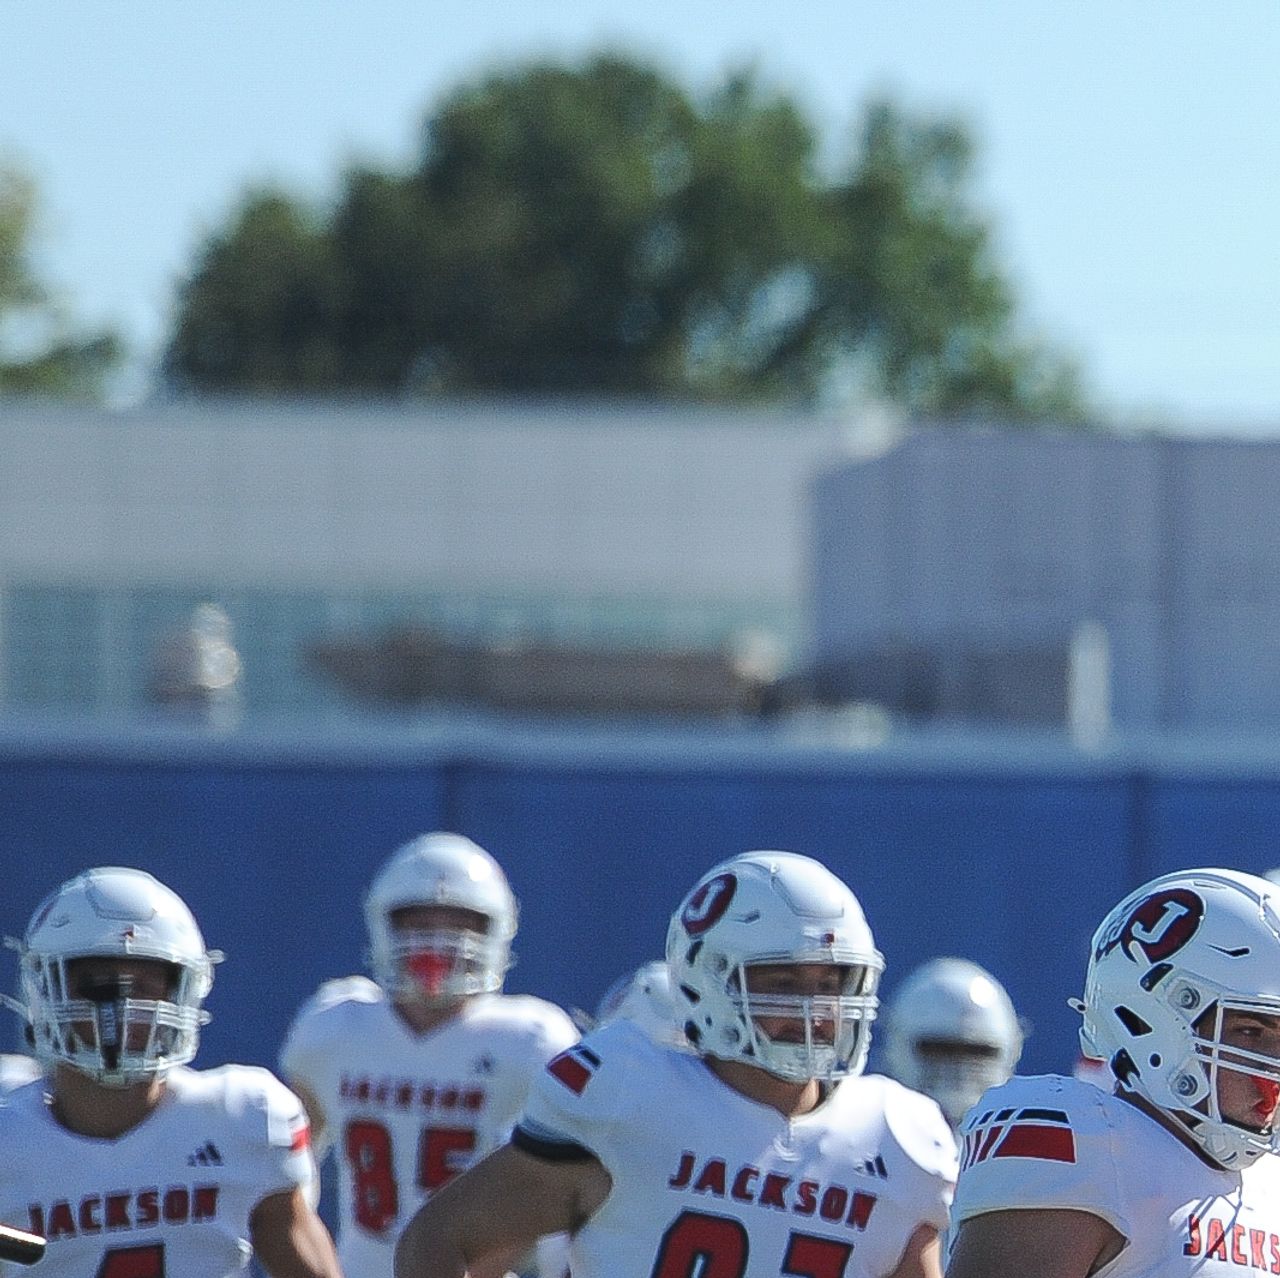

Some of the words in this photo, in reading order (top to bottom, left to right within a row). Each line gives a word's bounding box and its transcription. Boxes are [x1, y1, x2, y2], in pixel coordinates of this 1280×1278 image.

[1131, 901, 1190, 944] J
[28, 1184, 219, 1240] JACKSON
[668, 1151, 878, 1231] JACKSON
